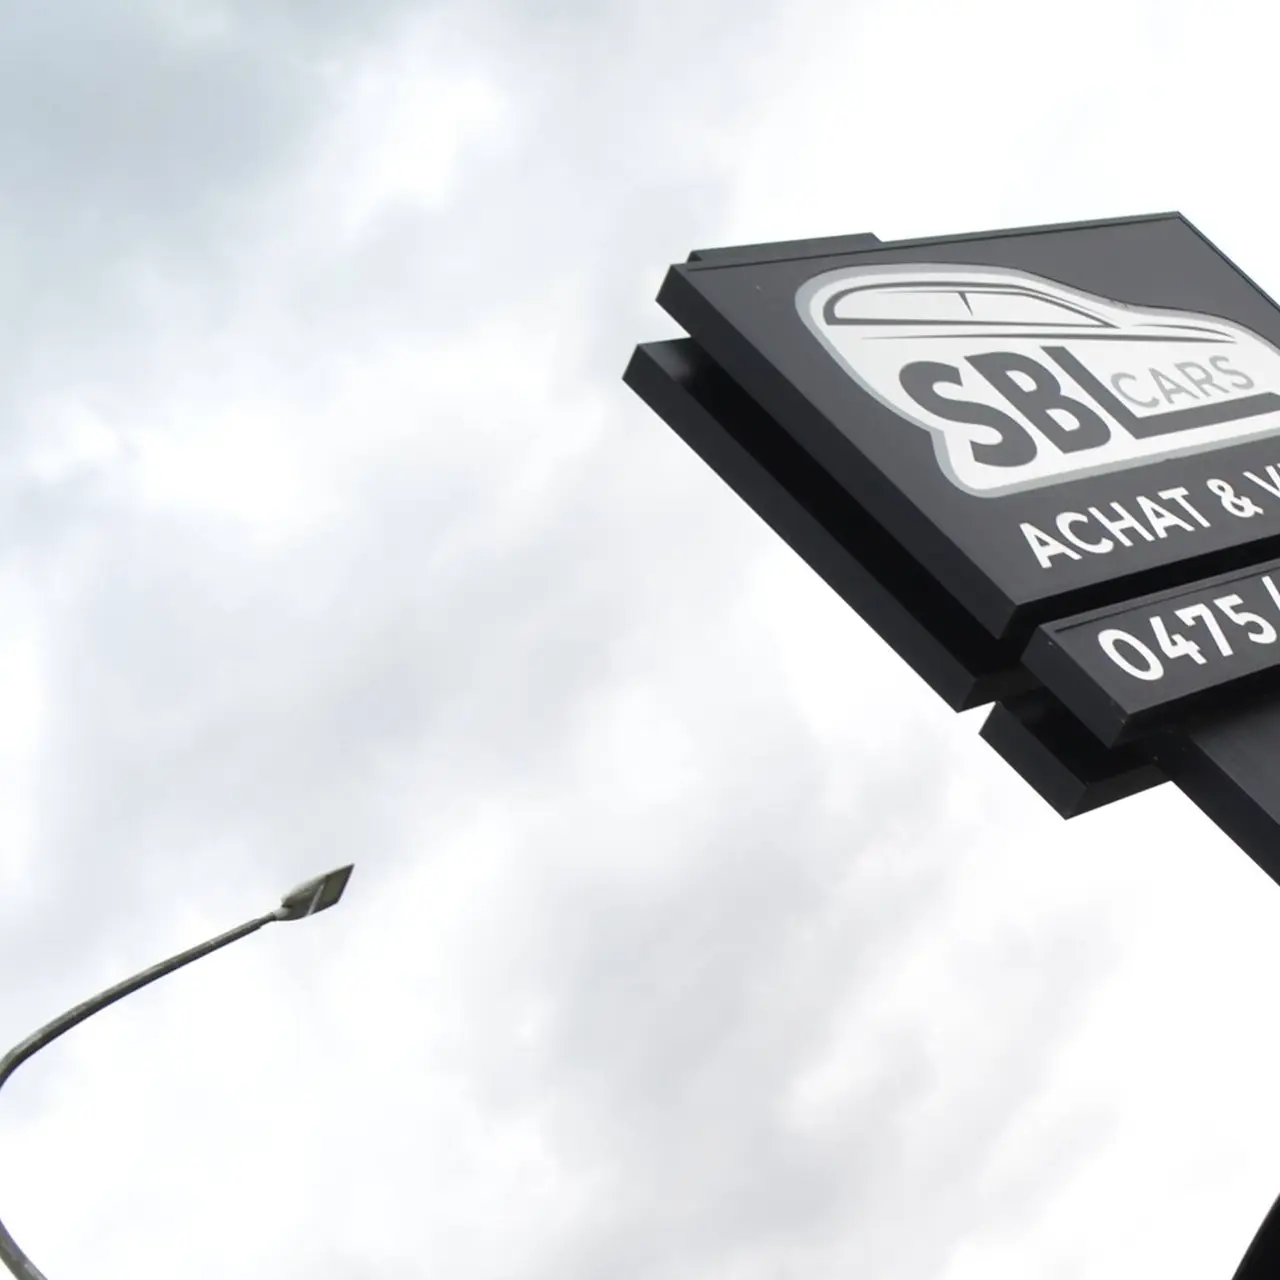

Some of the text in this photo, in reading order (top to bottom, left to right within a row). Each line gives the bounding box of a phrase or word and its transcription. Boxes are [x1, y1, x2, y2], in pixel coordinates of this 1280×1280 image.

[1110, 355, 1255, 408] CARS
[1019, 486, 1211, 569] ACHAT
[1206, 478, 1264, 519] &
